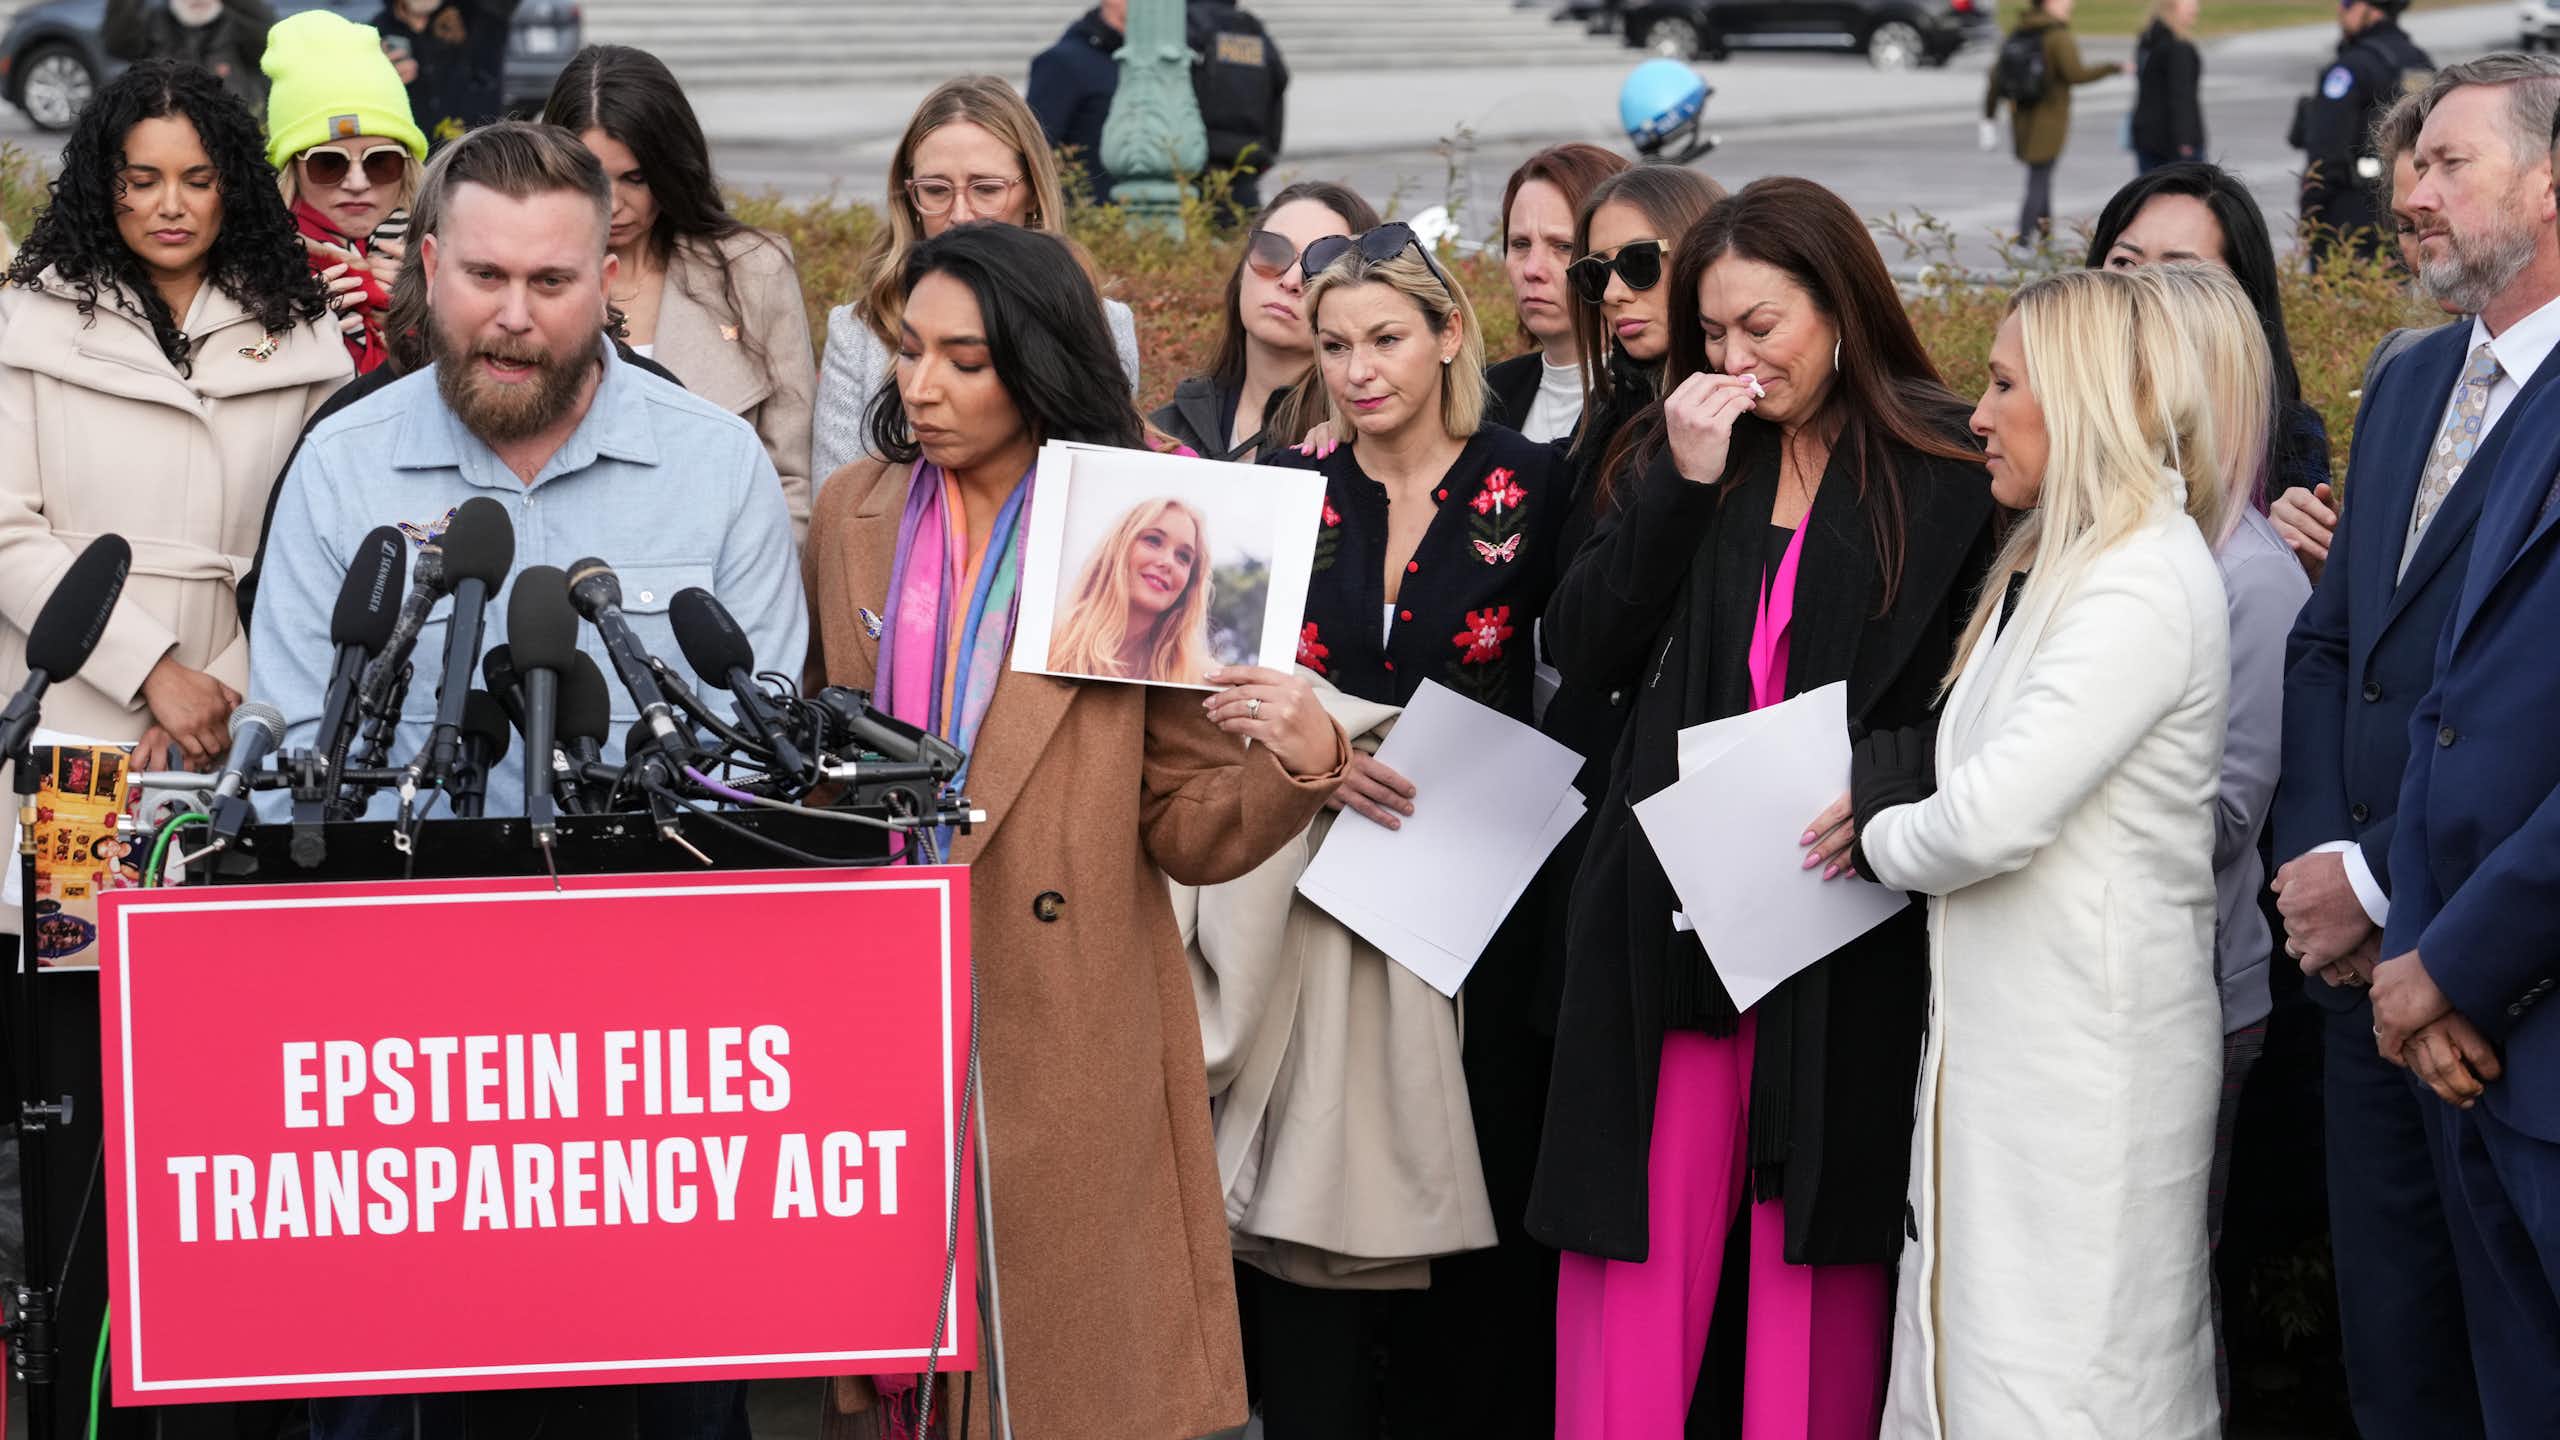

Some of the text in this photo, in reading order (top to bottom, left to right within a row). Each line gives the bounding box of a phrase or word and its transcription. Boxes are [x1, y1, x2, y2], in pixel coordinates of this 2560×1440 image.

[368, 556, 392, 613] SENNHEISER
[282, 1024, 791, 1129] EPSTEIN FILES
[166, 1129, 907, 1243] TRANSPARENCY ACT
